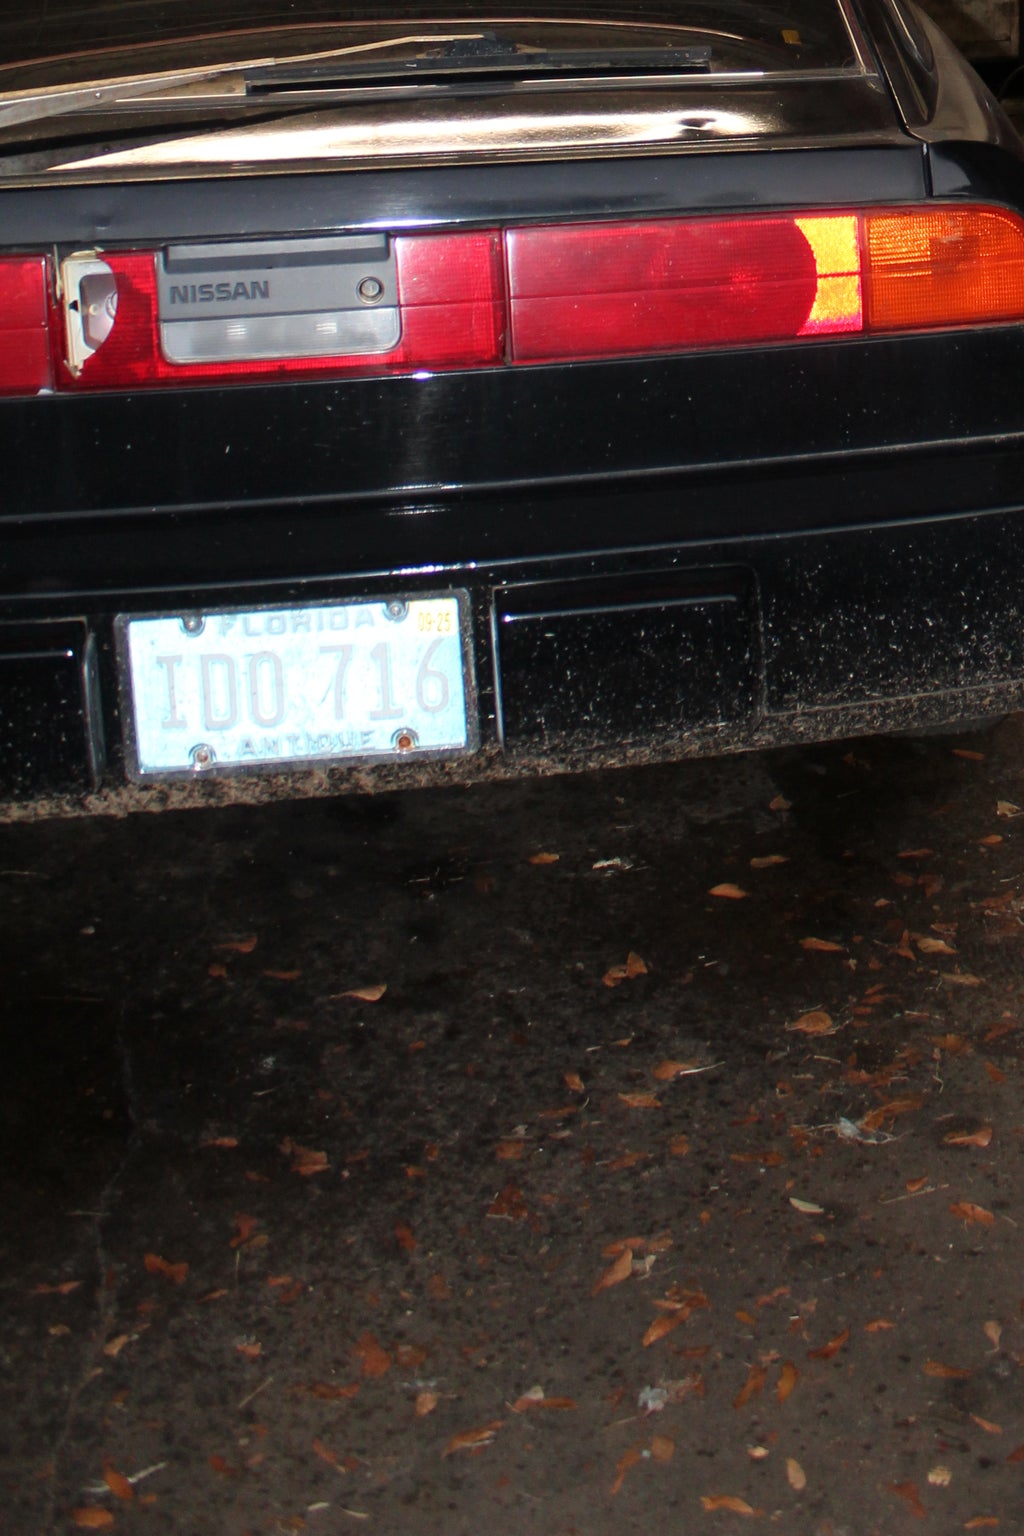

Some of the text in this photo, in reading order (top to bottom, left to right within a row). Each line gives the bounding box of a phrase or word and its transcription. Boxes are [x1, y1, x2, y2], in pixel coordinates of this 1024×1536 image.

[169, 279, 271, 305] NISSAN
[219, 607, 376, 637] FLORIDA
[318, 638, 451, 722] 716
[236, 729, 377, 758] ANTIQUE
